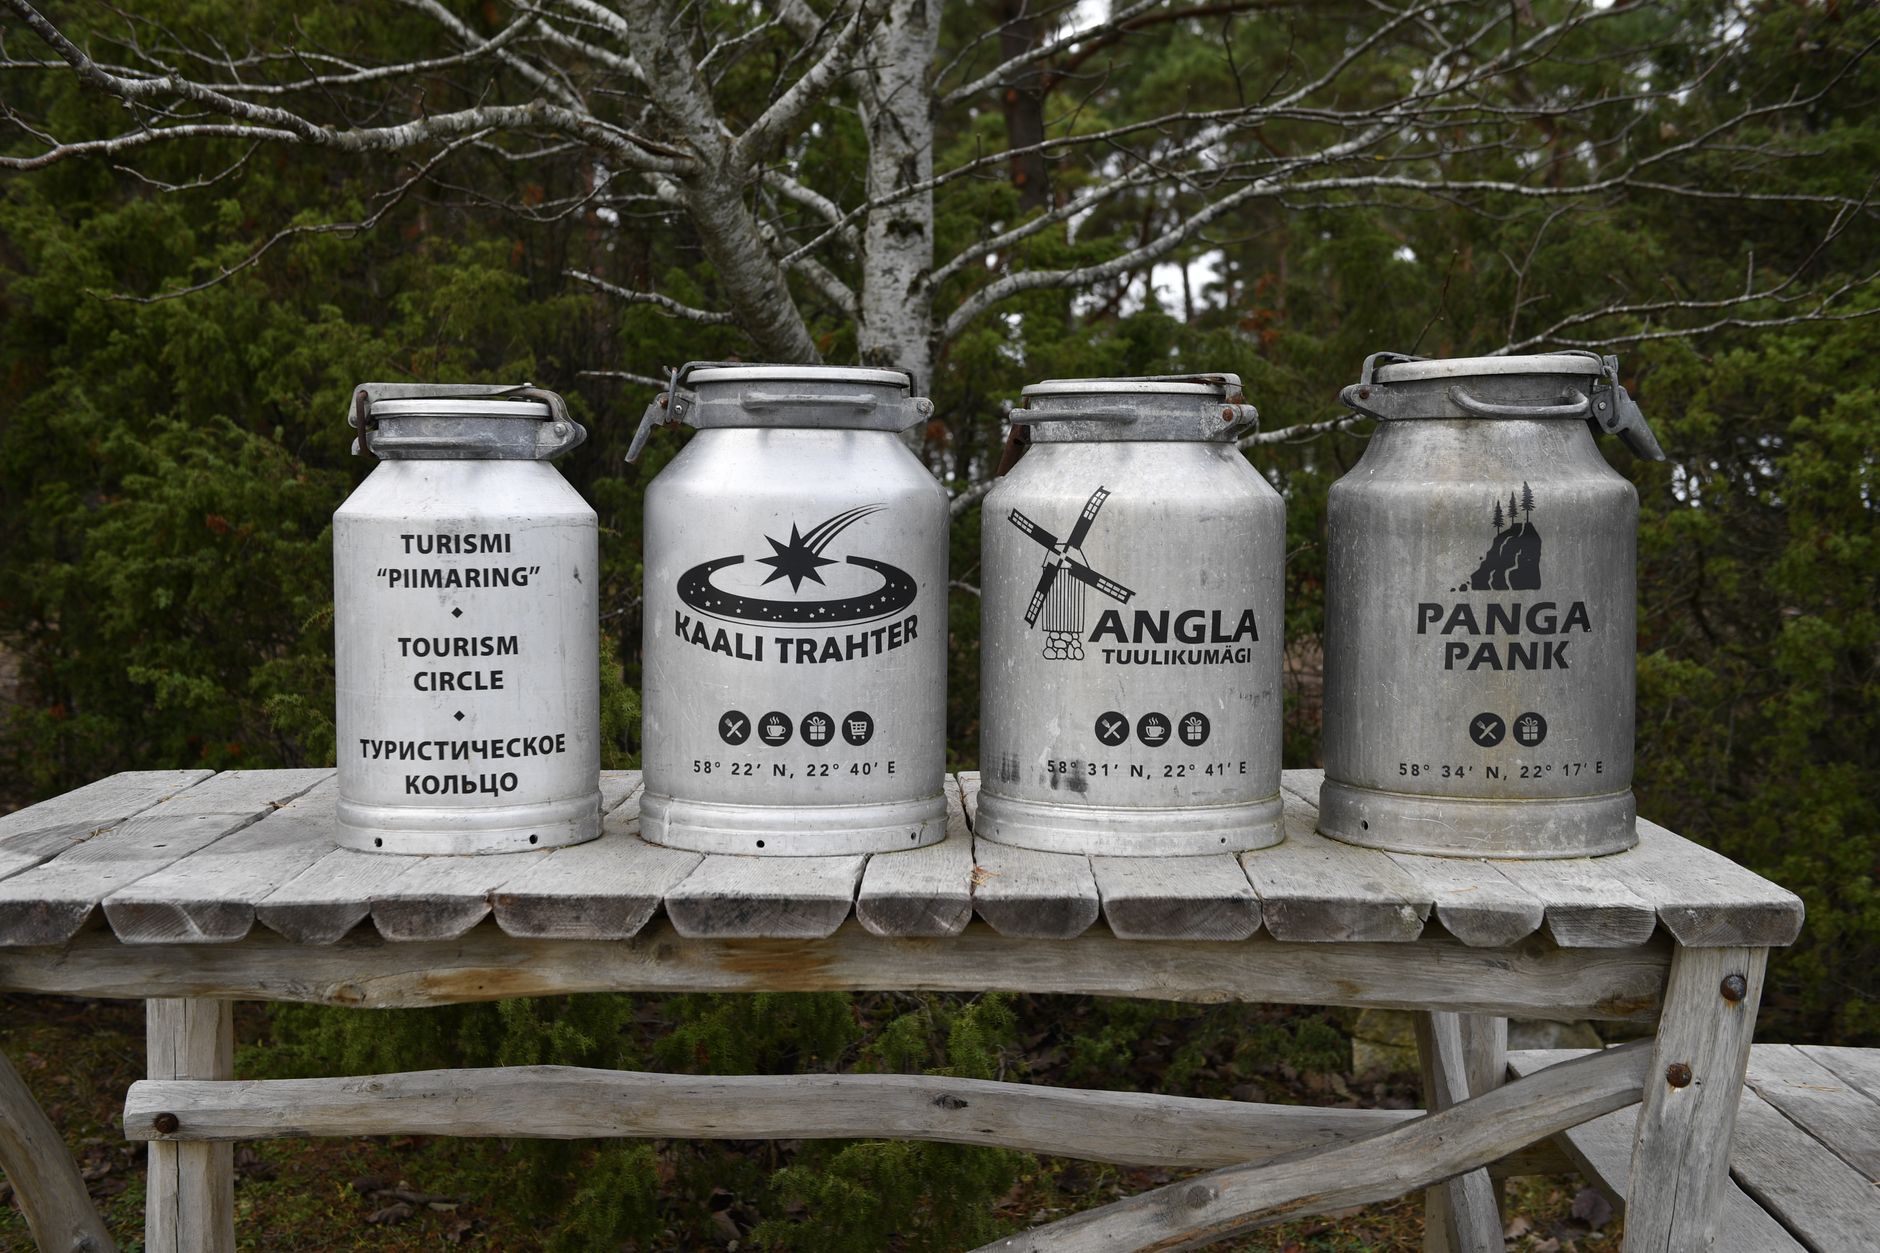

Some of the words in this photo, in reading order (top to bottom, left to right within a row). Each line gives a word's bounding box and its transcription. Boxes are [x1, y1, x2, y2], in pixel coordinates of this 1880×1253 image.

[401, 533, 511, 554] TURISMI
[1088, 609, 1259, 644] ANGLA
[1416, 601, 1592, 635] PANGA
[398, 636, 519, 657] TOURISM
[675, 609, 763, 662] KAALI
[774, 614, 919, 664] TRAHTER
[1102, 645, 1251, 665] TUULIKUMÄGI
[1444, 641, 1570, 671] PANK
[413, 670, 504, 692] CIRCLE
[359, 733, 566, 761] ТУРИСТИЧЕСКОЕ
[887, 761, 896, 774] E
[1239, 761, 1246, 775] E
[1595, 761, 1603, 774] E
[405, 772, 518, 797] КОЛЬЦО
